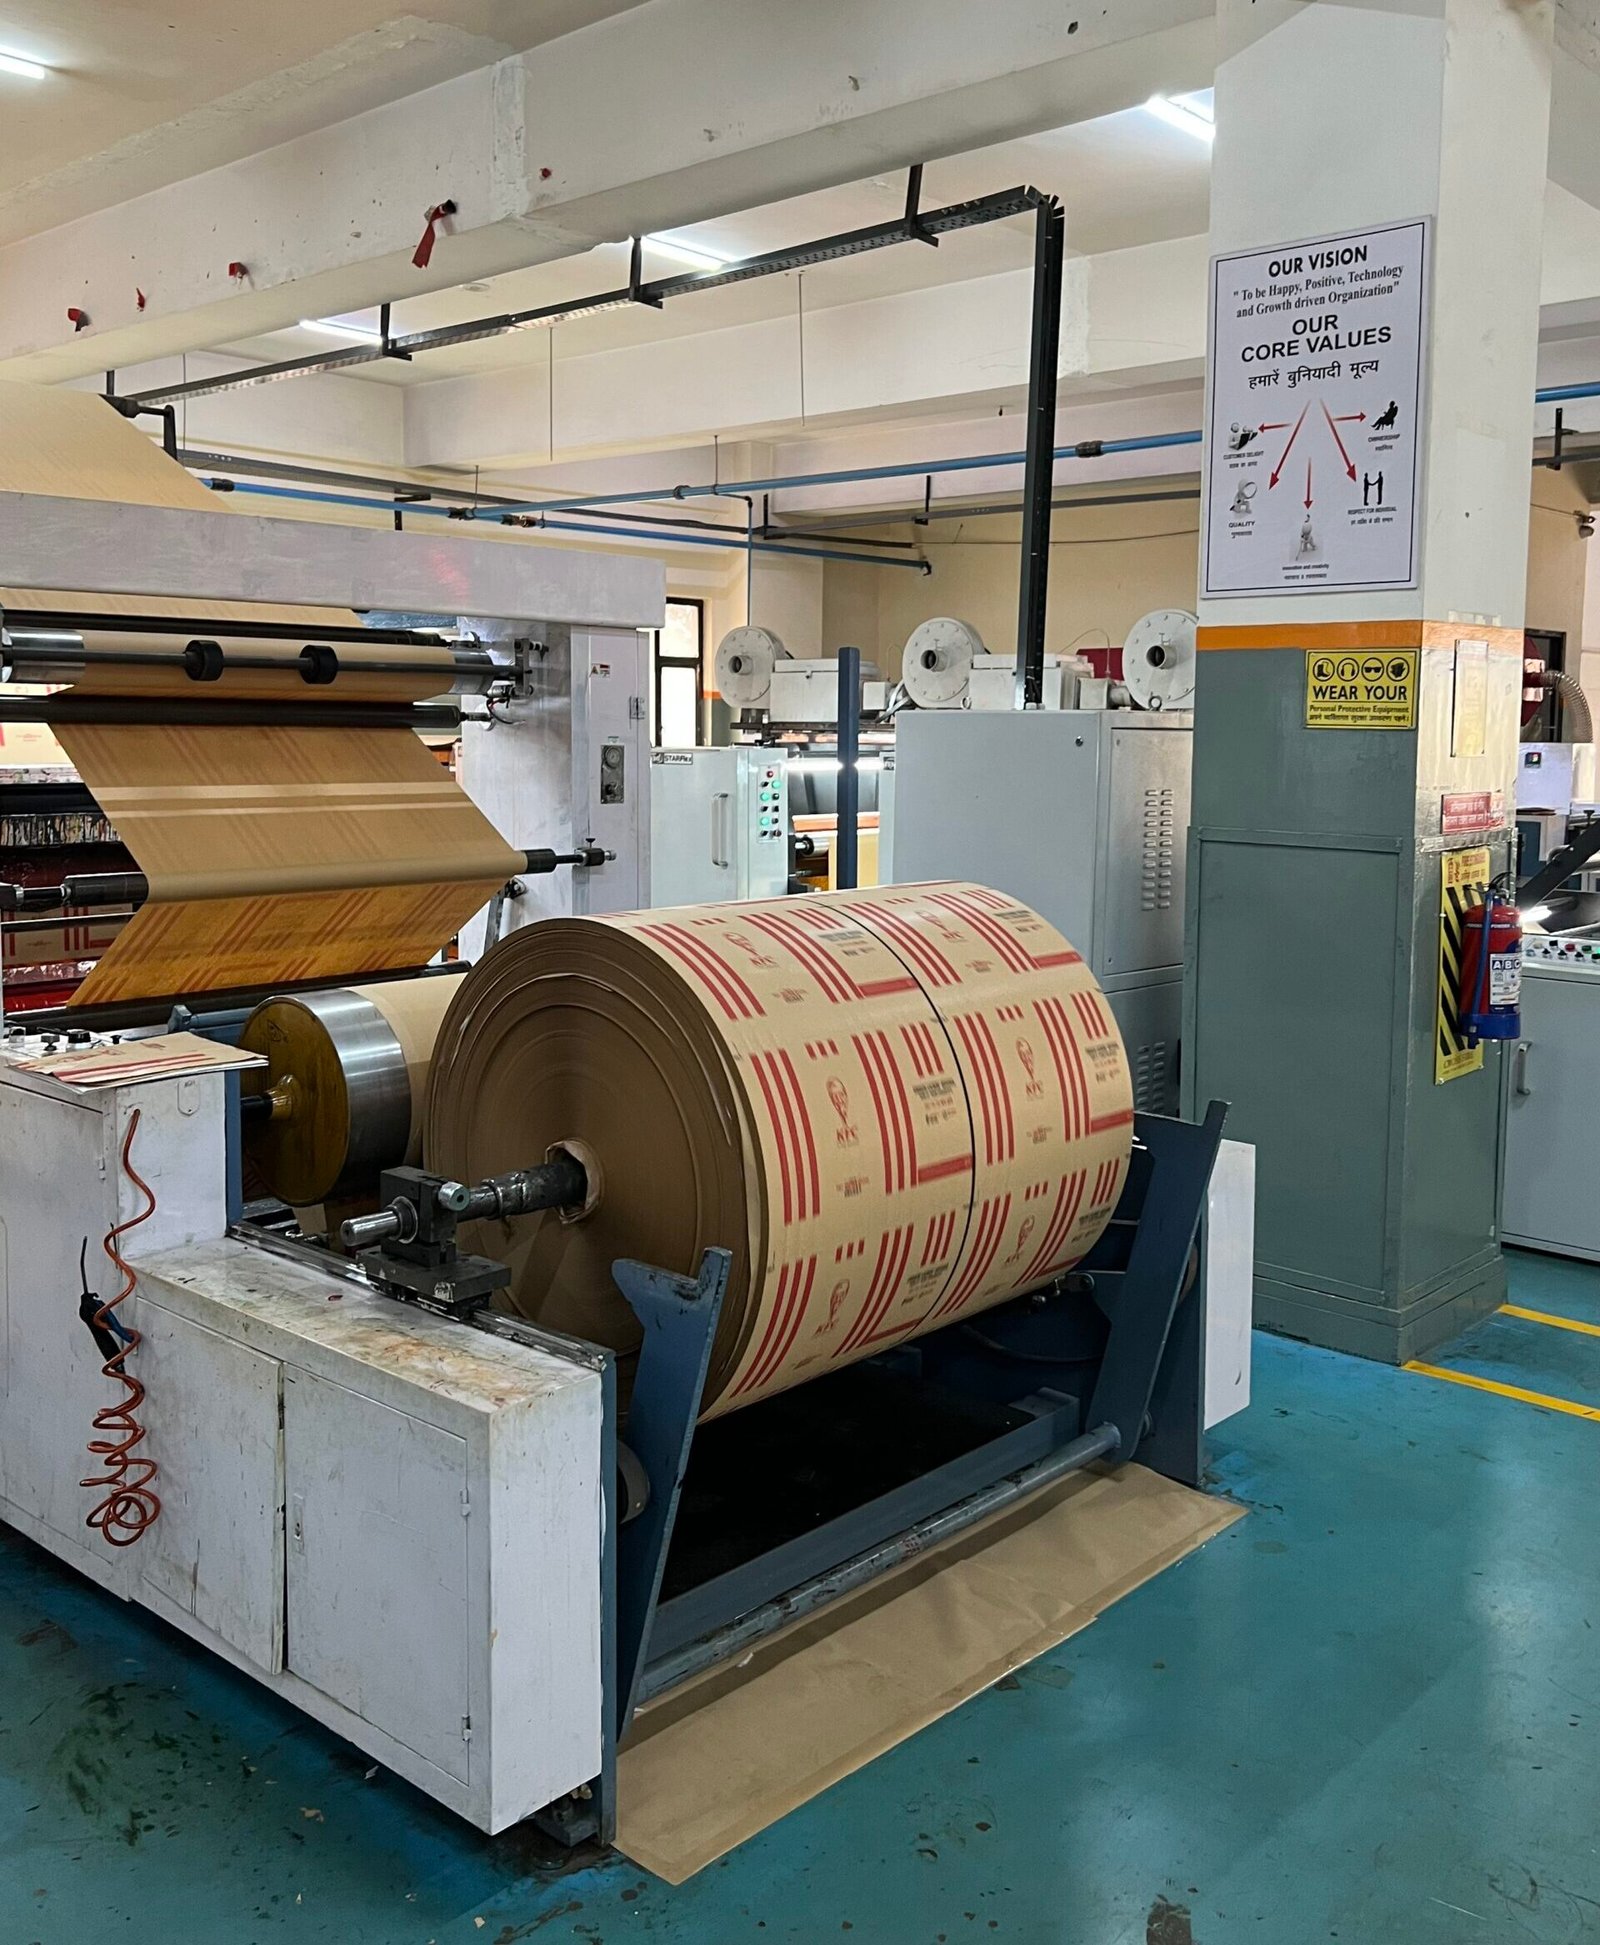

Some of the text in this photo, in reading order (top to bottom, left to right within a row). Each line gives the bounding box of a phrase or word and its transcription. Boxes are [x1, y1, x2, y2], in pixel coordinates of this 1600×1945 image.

[1268, 245, 1368, 277] OUR VISION
[1241, 289, 1253, 301] To
[1255, 287, 1266, 299] be
[1269, 283, 1302, 298] Happy,
[1305, 274, 1345, 291] Positive,
[1348, 265, 1404, 283] Technology
[1236, 280, 1400, 318] and Growth driven Organization"
[1292, 314, 1339, 336] OUR
[1241, 326, 1392, 363] CORE VALUES
[1350, 359, 1379, 380] मूल्य
[1228, 520, 1256, 528] QUALITY
[1312, 685, 1408, 700] WEAR YOUR
[1309, 704, 1409, 714] Personal Protective Equipment
